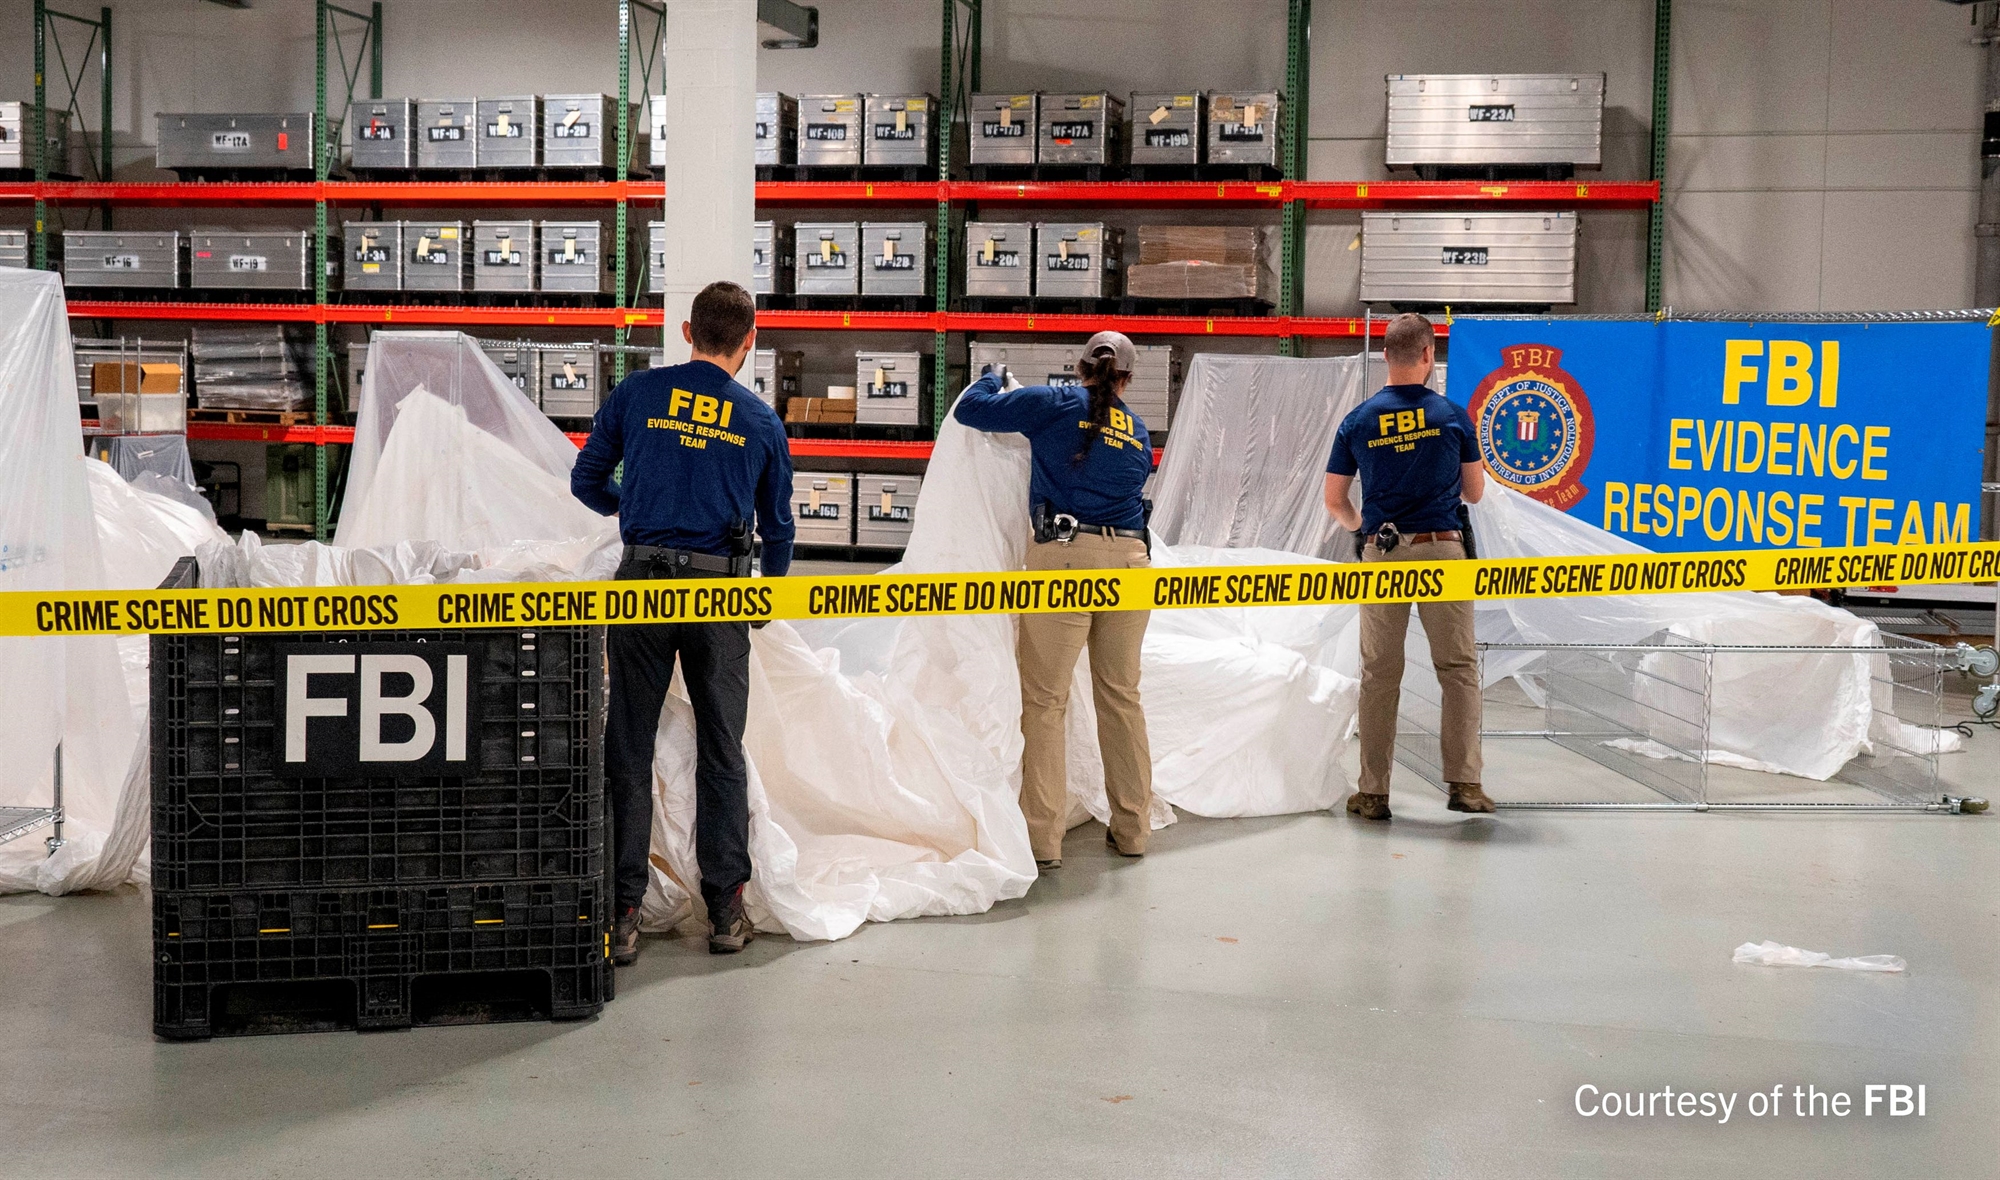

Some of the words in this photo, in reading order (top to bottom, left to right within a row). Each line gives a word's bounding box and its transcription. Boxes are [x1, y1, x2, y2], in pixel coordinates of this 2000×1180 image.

[1469, 109, 1514, 121] WF-23A
[214, 135, 248, 147] WF-17A
[489, 125, 519, 137] W2A
[809, 128, 845, 139] WF-10B
[1052, 125, 1089, 137] WF-17A
[1151, 134, 1189, 147] WF-19B
[417, 252, 446, 263] -3B
[489, 252, 520, 264] WFB
[554, 253, 585, 264] WFA
[1442, 252, 1487, 265] WF-23B
[1511, 348, 1555, 369] FBI
[1722, 338, 1840, 408] FBI
[668, 387, 733, 428] FBI
[1488, 385, 1514, 412] DEPT.
[1516, 381, 1531, 391] OF
[1533, 382, 1571, 414] JUSTICE
[647, 418, 694, 434] EVIDENCE
[695, 425, 747, 447] RESPONSE
[1109, 406, 1134, 436] BI
[1378, 407, 1426, 436] FBI
[679, 434, 707, 450] TEAM
[1103, 436, 1124, 450] TEAM
[1367, 435, 1404, 448] EVIDENCE
[1404, 428, 1441, 441] RESPONSE
[1394, 442, 1416, 453] TEAM
[1481, 413, 1493, 459] FEDERAL
[1489, 458, 1523, 483] BUREAU
[1524, 475, 1537, 484] OF
[1539, 417, 1576, 482] INVESTIGATION
[1668, 418, 1891, 481] EVIDENCE
[1555, 483, 1580, 504] Team
[1603, 481, 1825, 548] RESPONSE
[1838, 496, 1971, 547] TEAM
[1474, 565, 1540, 596] CRIME
[1541, 562, 1604, 593] SCENE
[1609, 562, 1638, 592] DO
[1640, 561, 1682, 590] NOT
[1682, 559, 1748, 588] CROSS
[1774, 556, 1834, 586] CRIME
[1834, 554, 1897, 584] SCENE
[1900, 552, 1929, 582] DO
[1929, 551, 1970, 580] NOT
[809, 584, 880, 614] CRIME
[886, 582, 956, 613] SCENE
[964, 581, 994, 611] DO
[1000, 580, 1045, 610] NOT
[1048, 577, 1120, 608] CROSS
[1154, 575, 1222, 606] CRIME
[1225, 573, 1292, 604] SCENE
[1298, 572, 1328, 601] DO
[1331, 570, 1374, 600] NOT
[1376, 568, 1445, 598] CROSS
[36, 601, 119, 631] CRIME
[127, 600, 207, 630] SCENE
[218, 597, 253, 628] DO
[260, 596, 309, 627] NOT
[314, 594, 399, 626] CROSS
[438, 593, 515, 624] CRIME
[521, 590, 597, 622] SCENE
[606, 589, 637, 620] DO
[643, 588, 690, 618] NOT
[694, 586, 773, 618] CROSS
[285, 653, 468, 763] FBI
